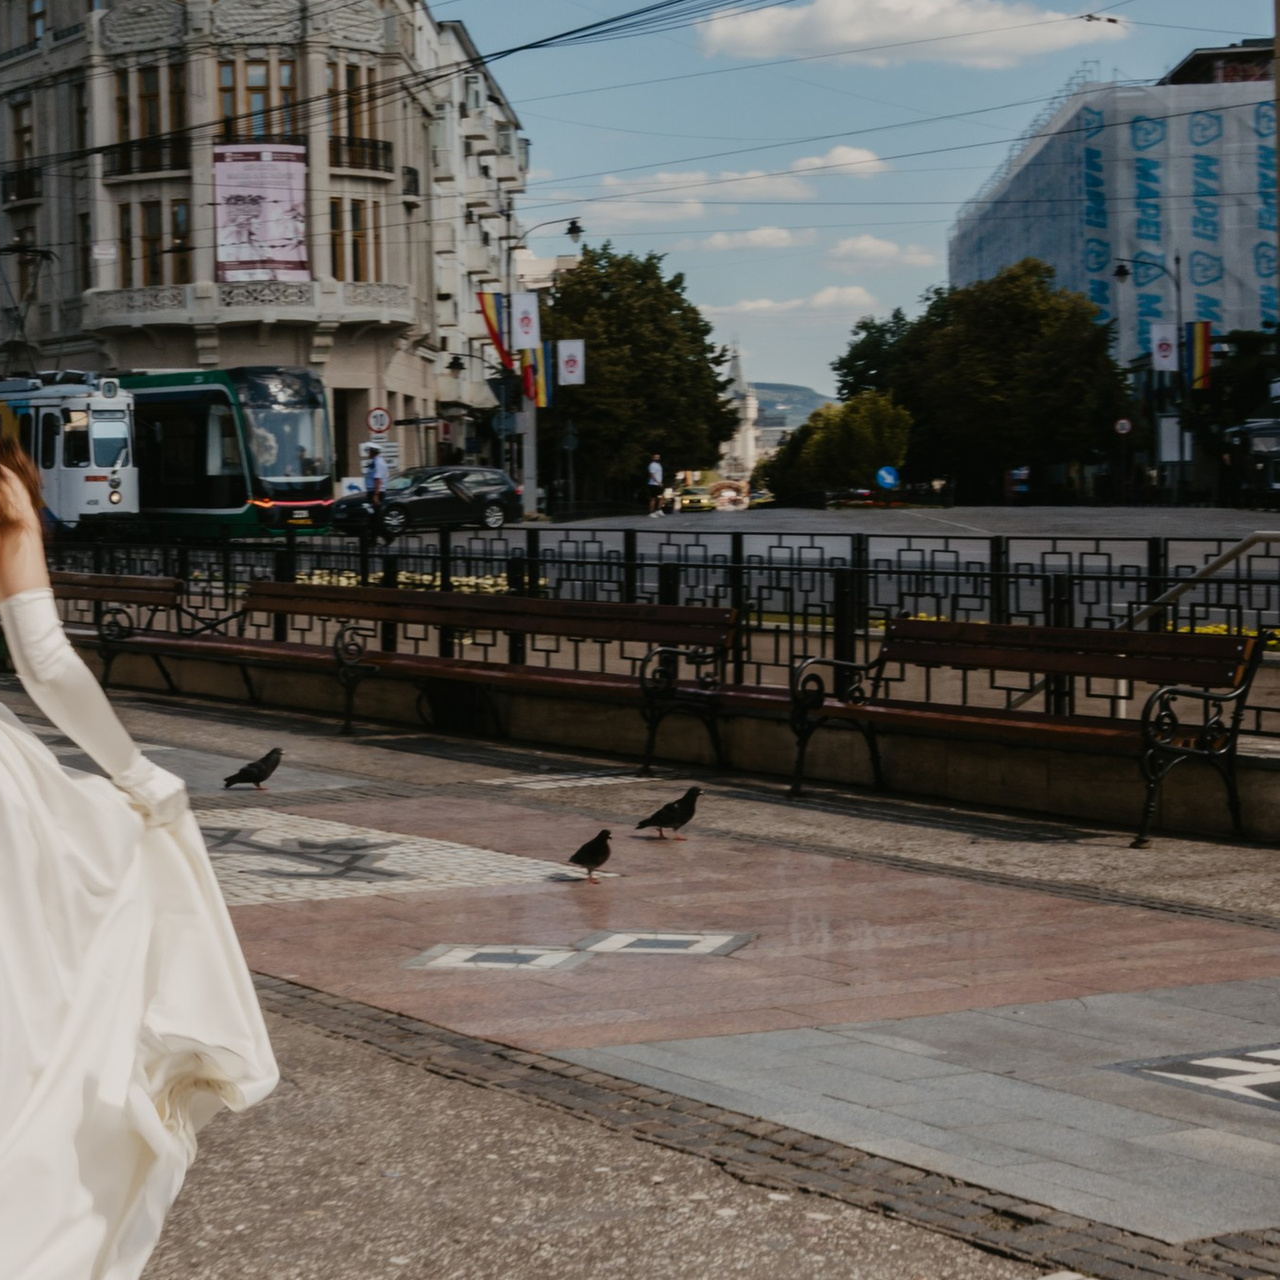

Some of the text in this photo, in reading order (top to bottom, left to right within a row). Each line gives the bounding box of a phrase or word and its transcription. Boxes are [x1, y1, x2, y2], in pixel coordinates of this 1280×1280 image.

[1085, 147, 1107, 229] MAPEI
[1135, 157, 1162, 241] MAPEI
[1192, 154, 1220, 241] MAPEI
